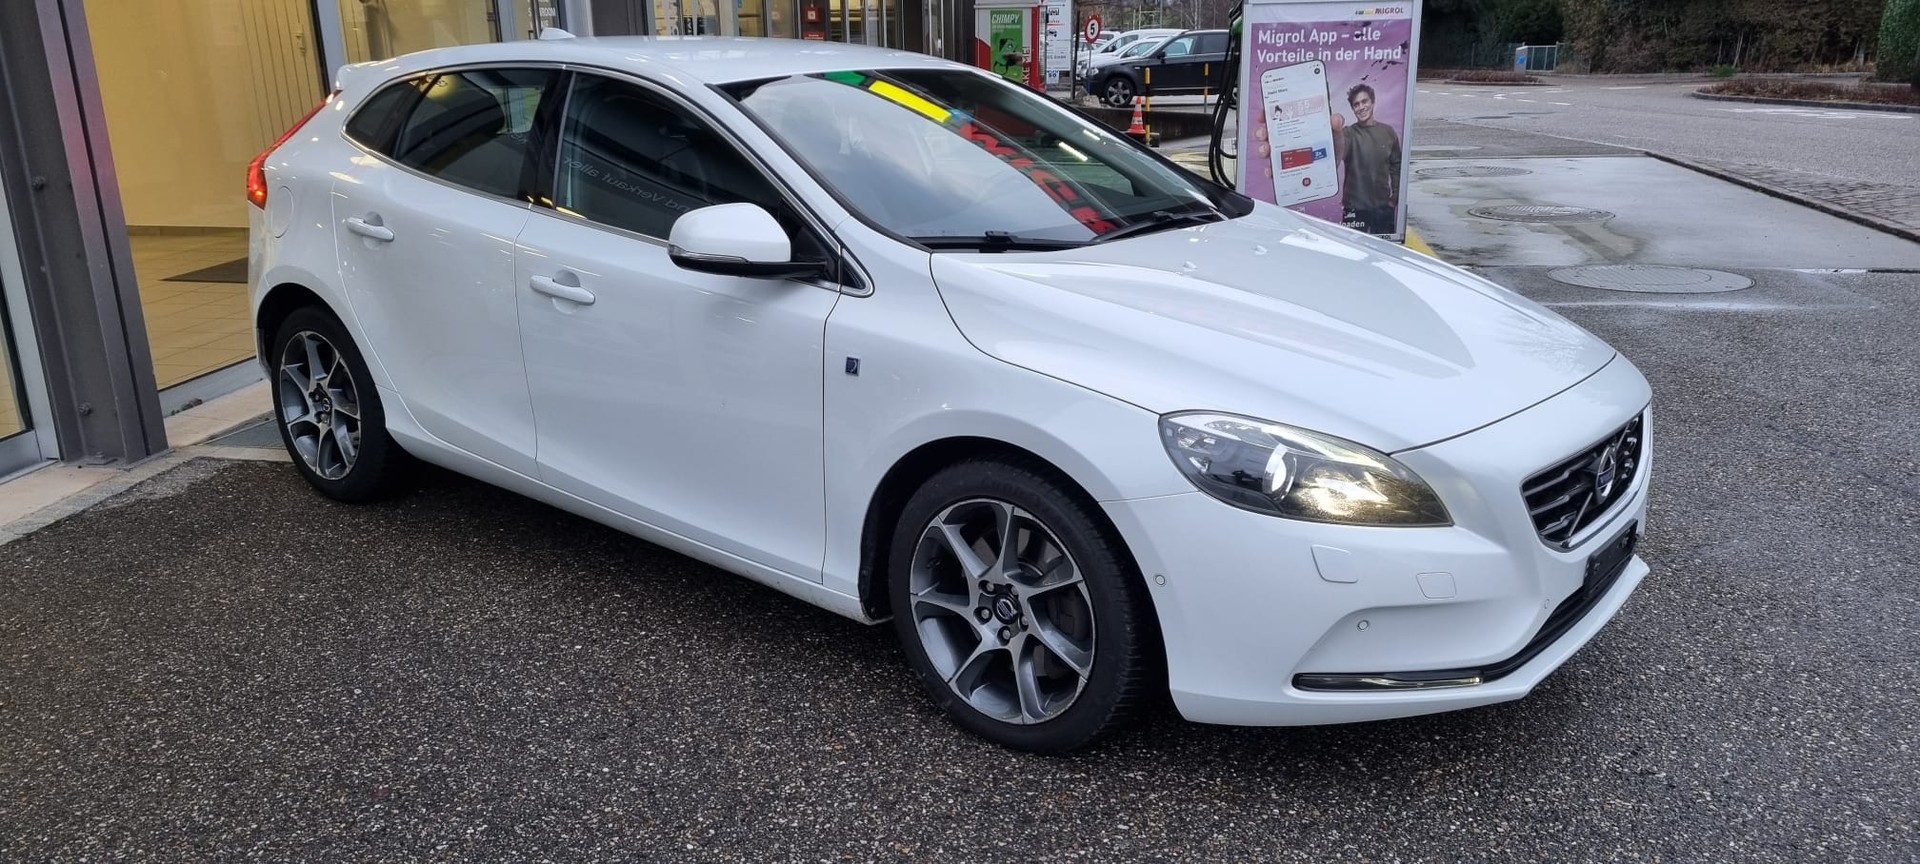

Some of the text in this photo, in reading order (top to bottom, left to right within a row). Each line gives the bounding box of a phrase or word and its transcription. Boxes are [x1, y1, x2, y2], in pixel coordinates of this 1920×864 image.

[1375, 7, 1404, 15] MIGROL
[991, 13, 1020, 24] CHIMPY
[1090, 23, 1096, 36] 5
[1258, 28, 1305, 47] Migrol
[1309, 29, 1337, 43] App
[1257, 46, 1402, 63] Vorteile in der Hand
